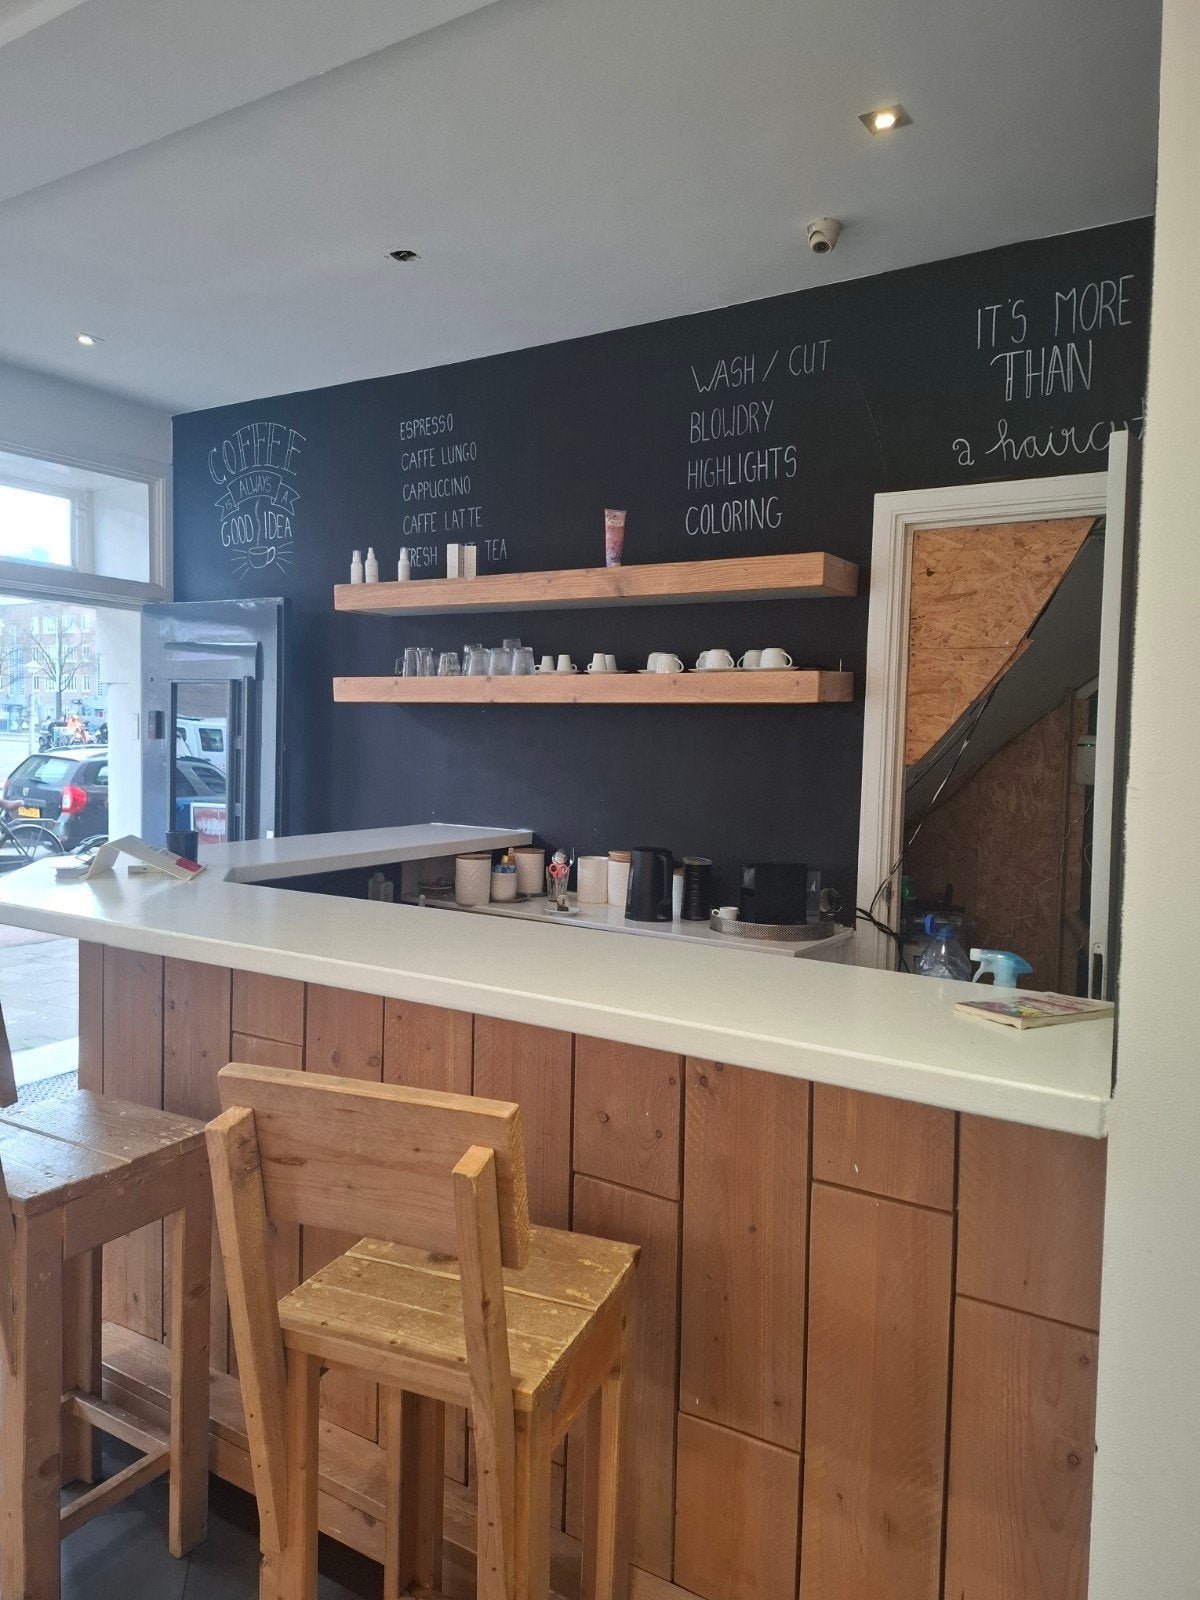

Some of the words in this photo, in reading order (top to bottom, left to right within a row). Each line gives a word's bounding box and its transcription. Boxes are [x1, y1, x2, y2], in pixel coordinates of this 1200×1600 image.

[976, 299, 1027, 350] IT'S
[1054, 274, 1135, 337] MORE
[690, 353, 755, 393] WASH
[762, 349, 780, 382] /
[788, 339, 832, 376] CUT
[990, 339, 1093, 401] THAN
[400, 413, 454, 441] ESPRESSO
[690, 399, 774, 444] BLOWDRY
[208, 421, 307, 485] COFFEE
[401, 447, 436, 471] CAFFE
[441, 441, 477, 466] LUNGO
[687, 445, 798, 491] HIGHLIGHTS
[952, 438, 975, 466] a
[239, 475, 272, 498] ALWAYS
[280, 490, 290, 503] A
[402, 475, 471, 502] CAPPUCCINO
[221, 514, 254, 547] GOOD
[264, 511, 293, 540] IDEA
[402, 512, 438, 535] CAFFE
[445, 506, 483, 531] LATTE
[685, 496, 783, 536] COLORING
[408, 545, 438, 567] RESH
[484, 538, 508, 561] TEA
